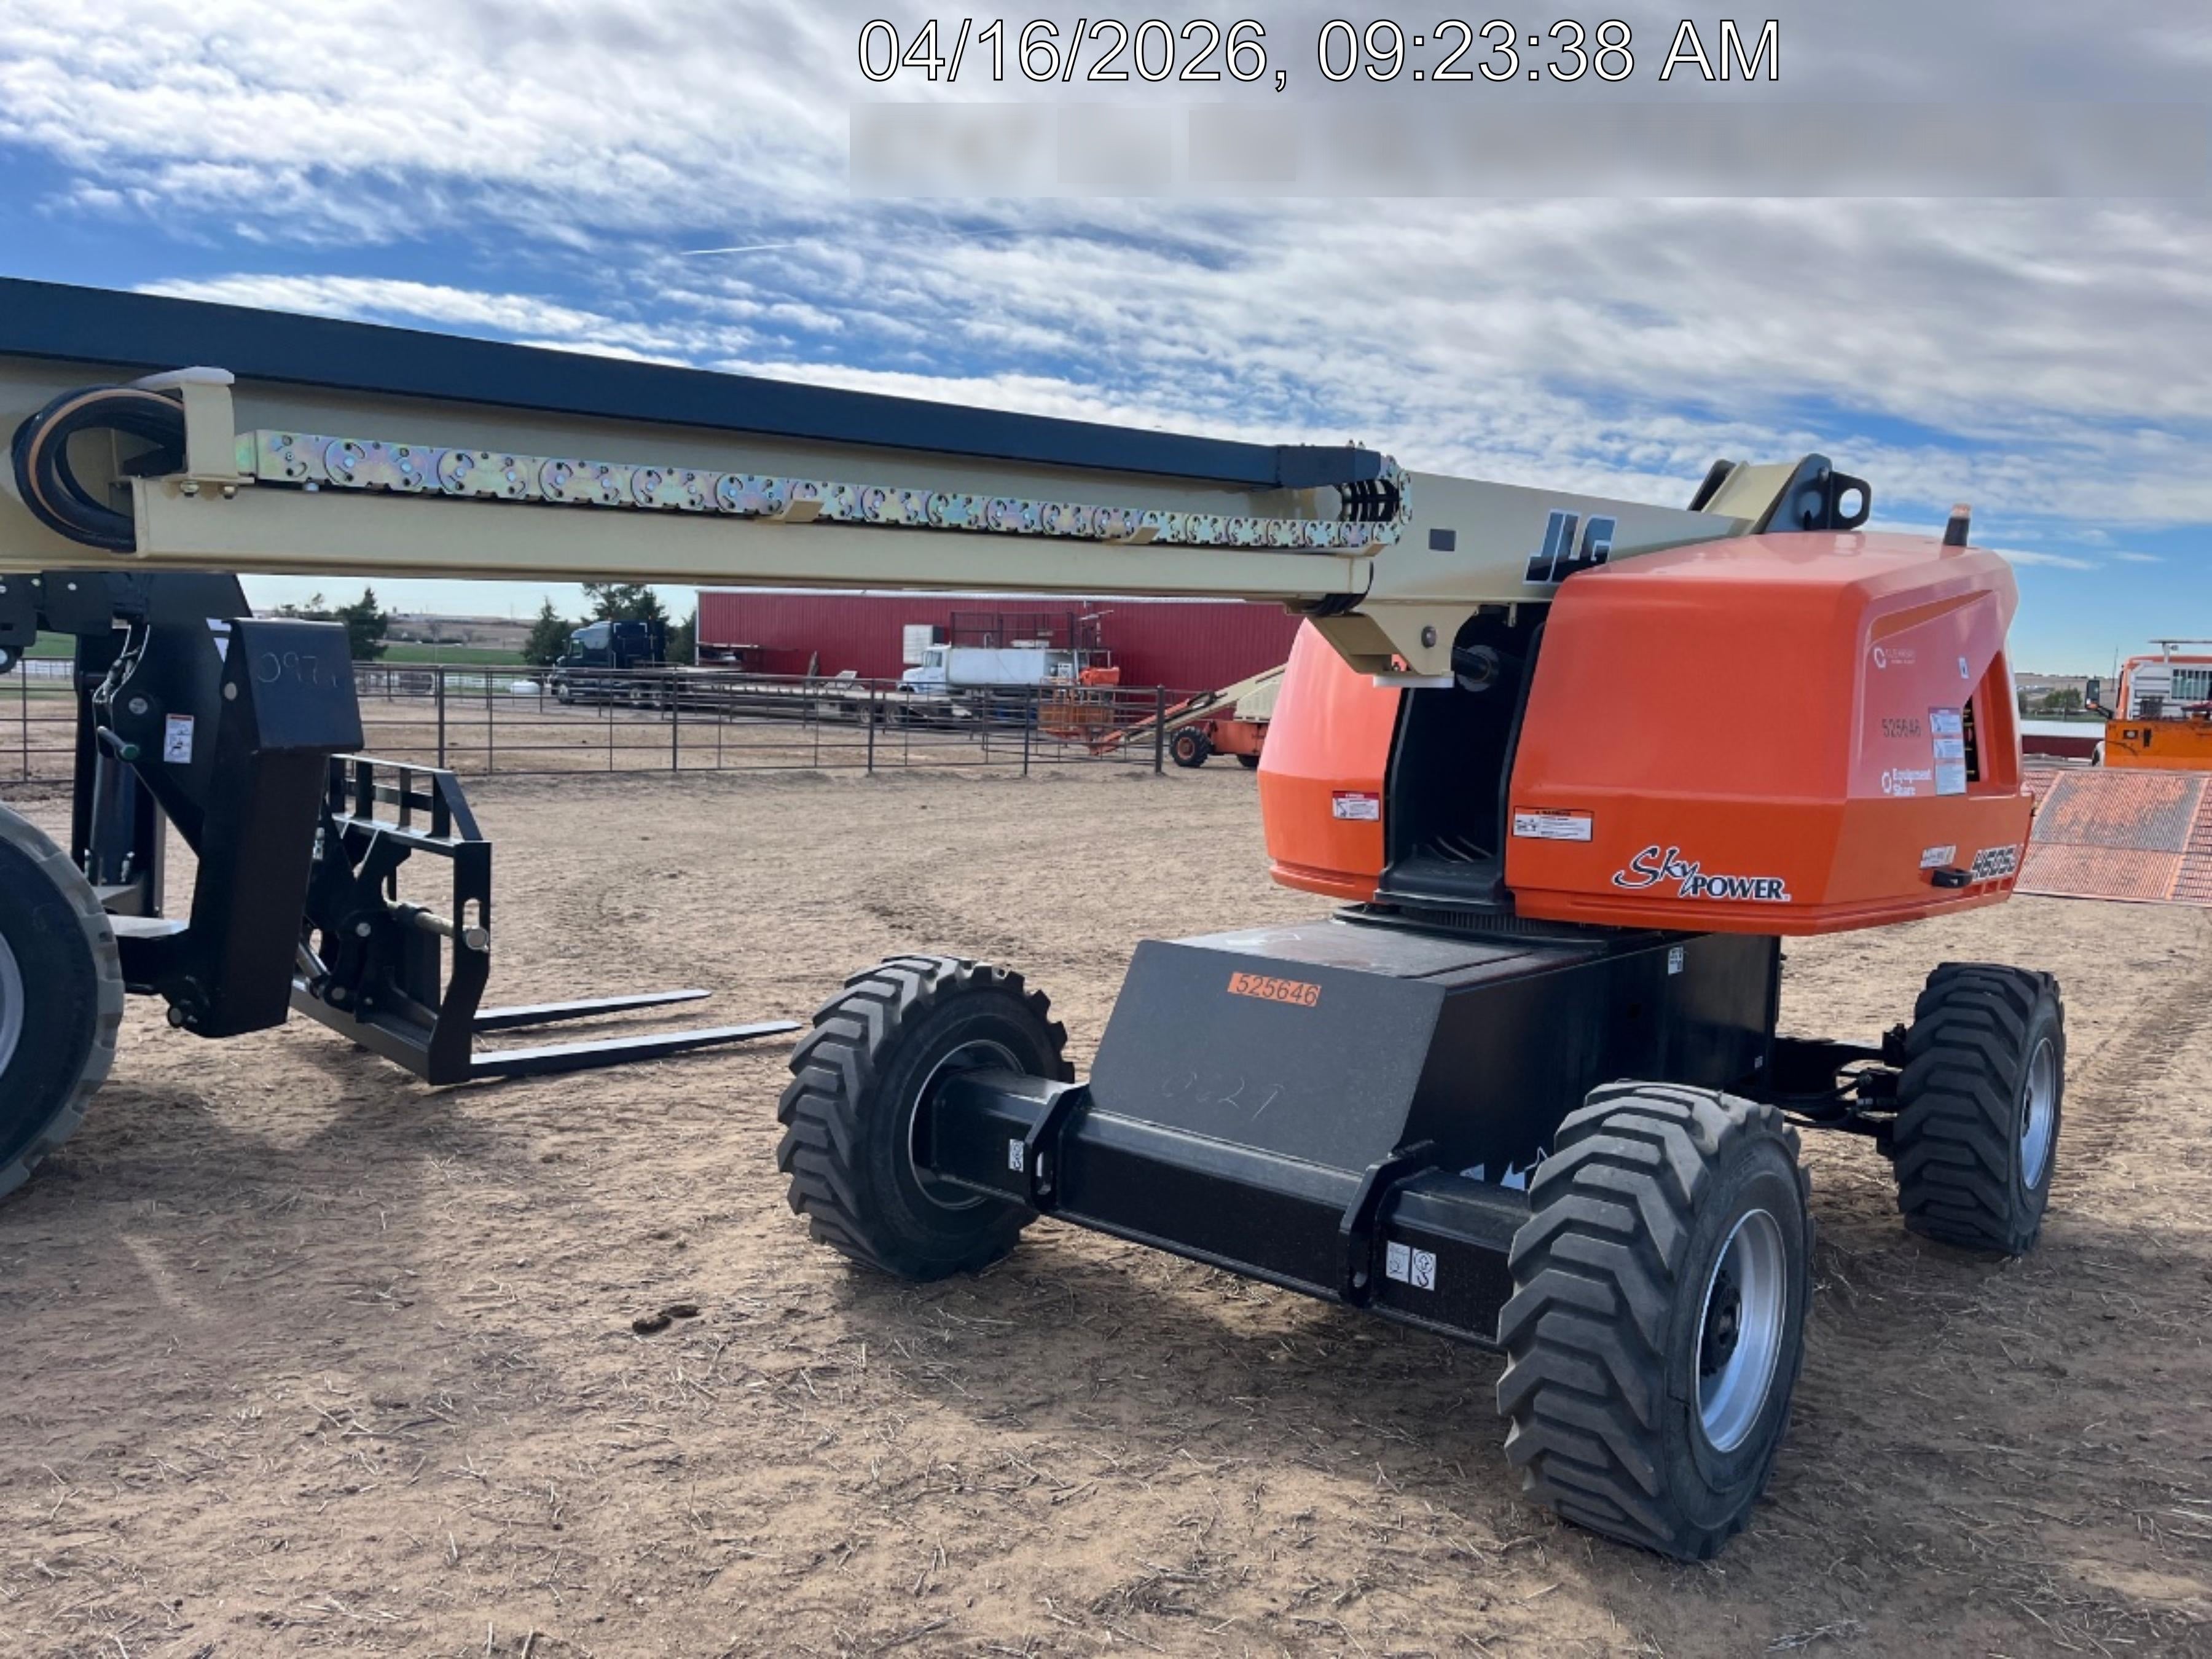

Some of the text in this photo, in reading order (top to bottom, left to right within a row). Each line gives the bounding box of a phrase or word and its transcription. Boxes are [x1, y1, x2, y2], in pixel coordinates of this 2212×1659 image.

[1611, 845, 1700, 898] Sky
[1690, 874, 1786, 901] POWER
[1236, 974, 1319, 1005] 525646
